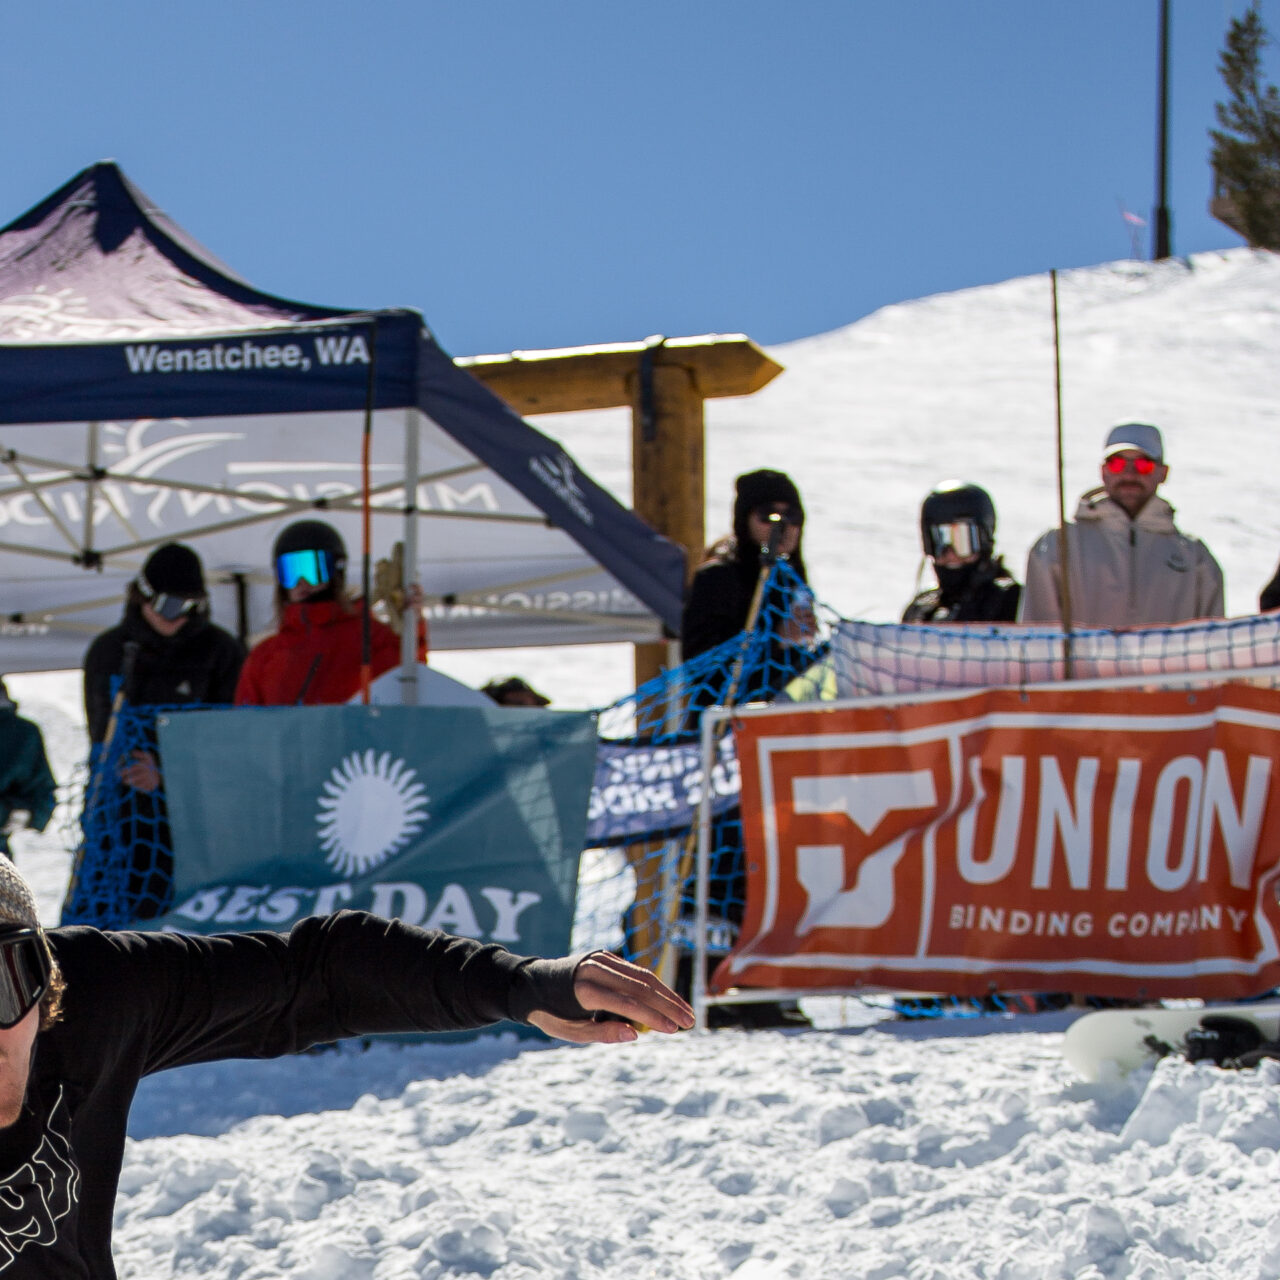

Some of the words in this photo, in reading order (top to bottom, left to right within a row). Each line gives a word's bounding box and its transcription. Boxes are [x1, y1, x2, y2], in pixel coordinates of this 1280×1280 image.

[125, 341, 311, 373] Wenatchee,
[315, 335, 371, 364] WA
[956, 748, 1272, 892] UNION
[175, 881, 354, 924] BEST
[371, 881, 541, 943] DAY
[949, 904, 1093, 937] BINDING
[1107, 904, 1246, 936] COMPANY
